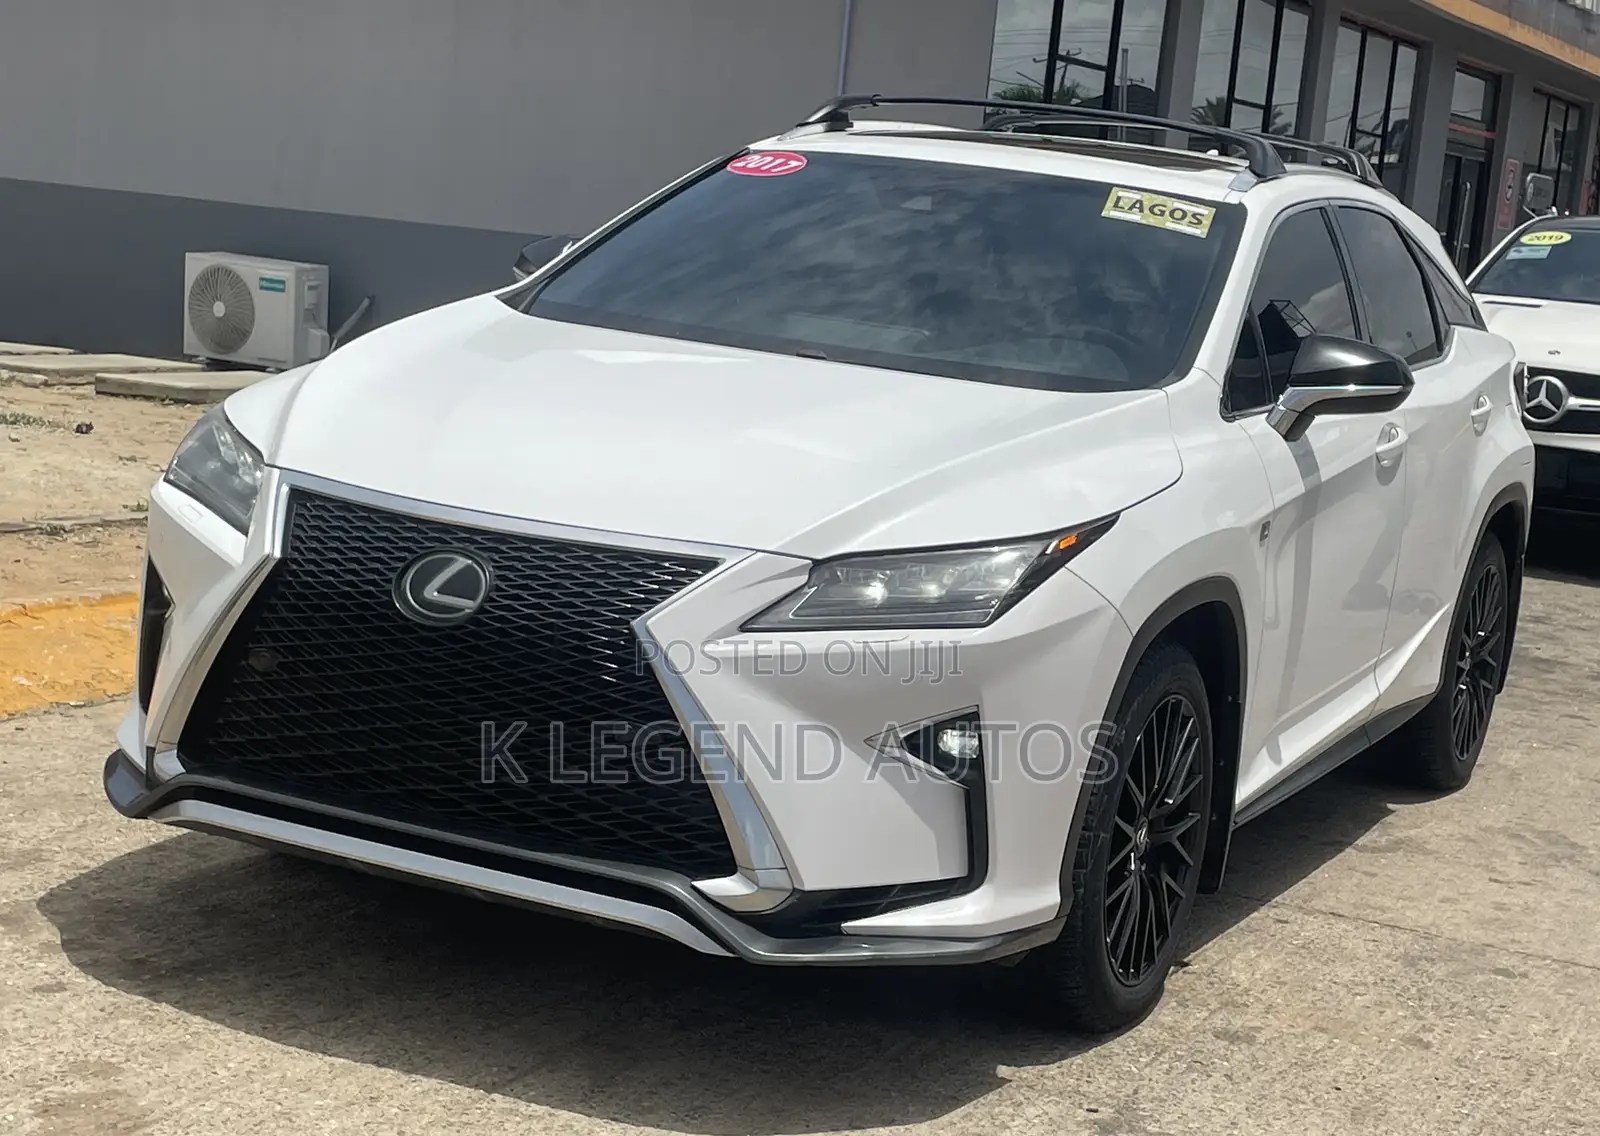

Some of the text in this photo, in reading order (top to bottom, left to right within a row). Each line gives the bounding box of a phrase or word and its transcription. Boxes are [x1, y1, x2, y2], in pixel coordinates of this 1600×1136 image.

[731, 154, 804, 173] 2017
[1112, 195, 1206, 226] LAGOS
[1527, 233, 1564, 242] 2019
